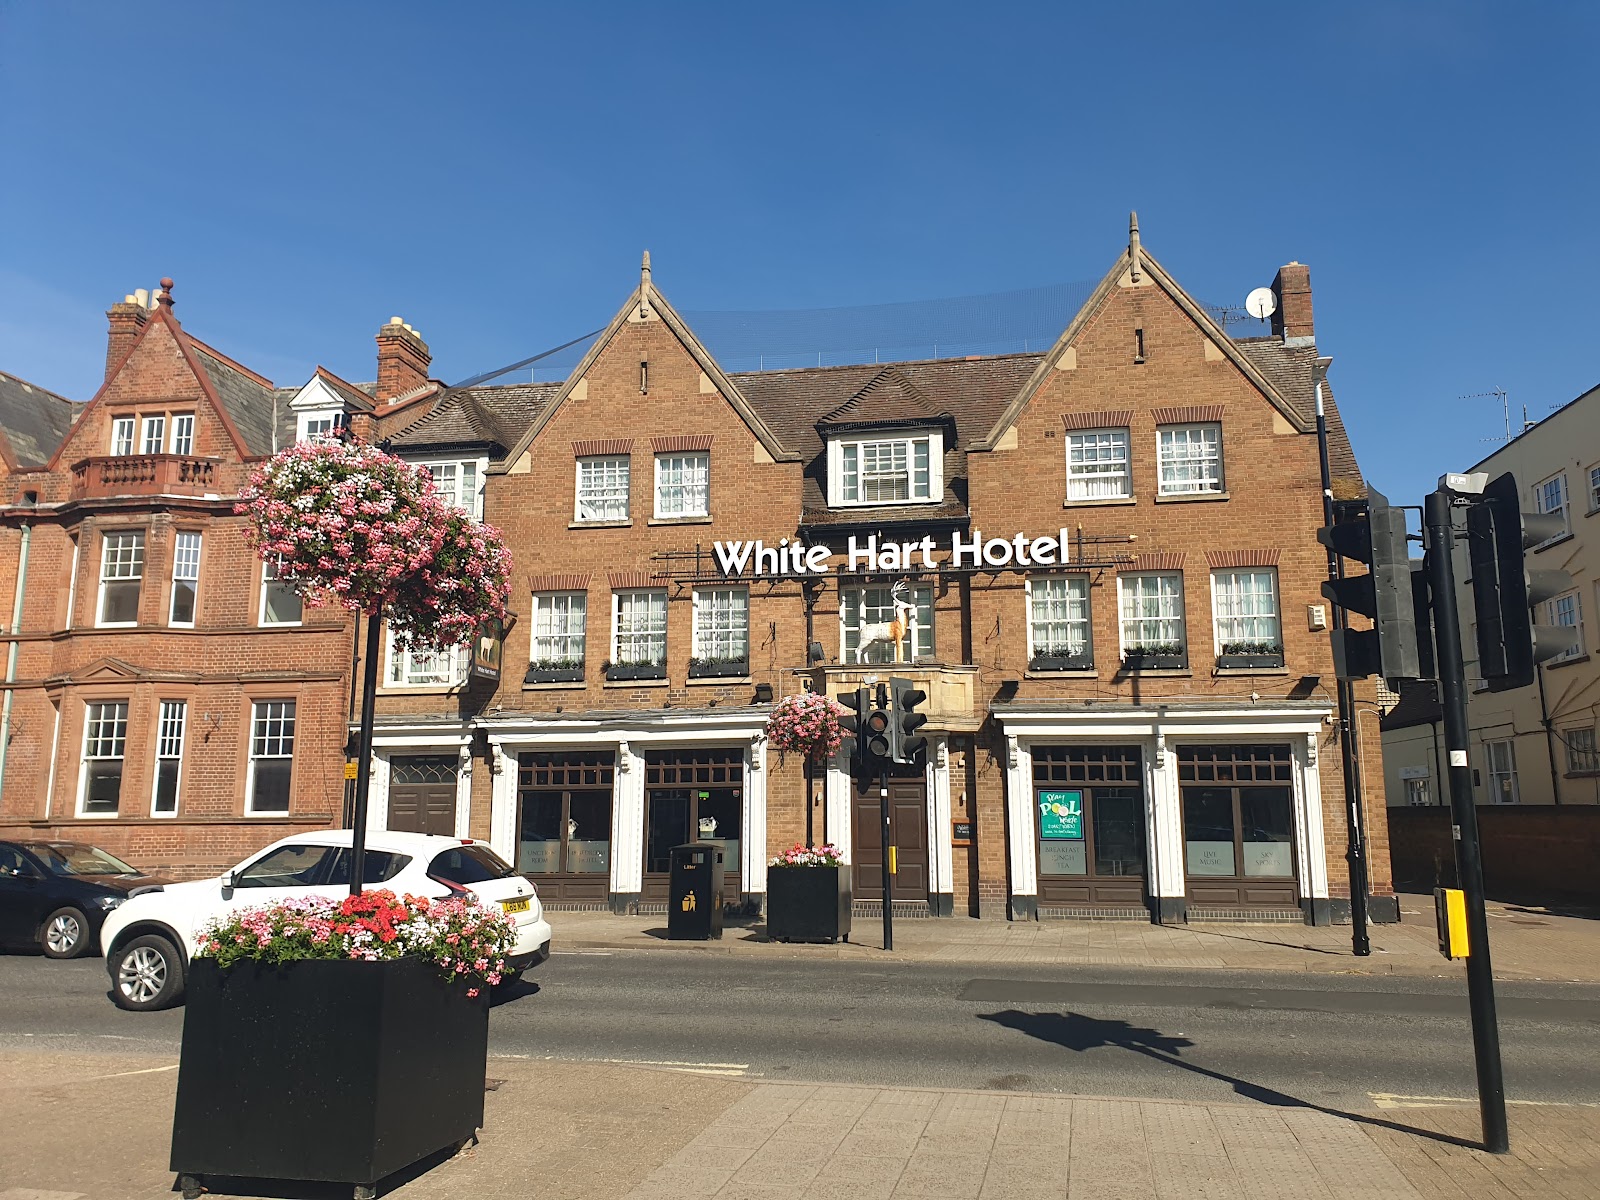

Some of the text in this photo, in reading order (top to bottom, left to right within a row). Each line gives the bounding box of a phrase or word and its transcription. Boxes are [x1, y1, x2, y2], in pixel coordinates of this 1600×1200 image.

[713, 527, 1070, 576] White Hart Hotel
[1046, 794, 1065, 803] Play
[1039, 800, 1082, 817] POOL
